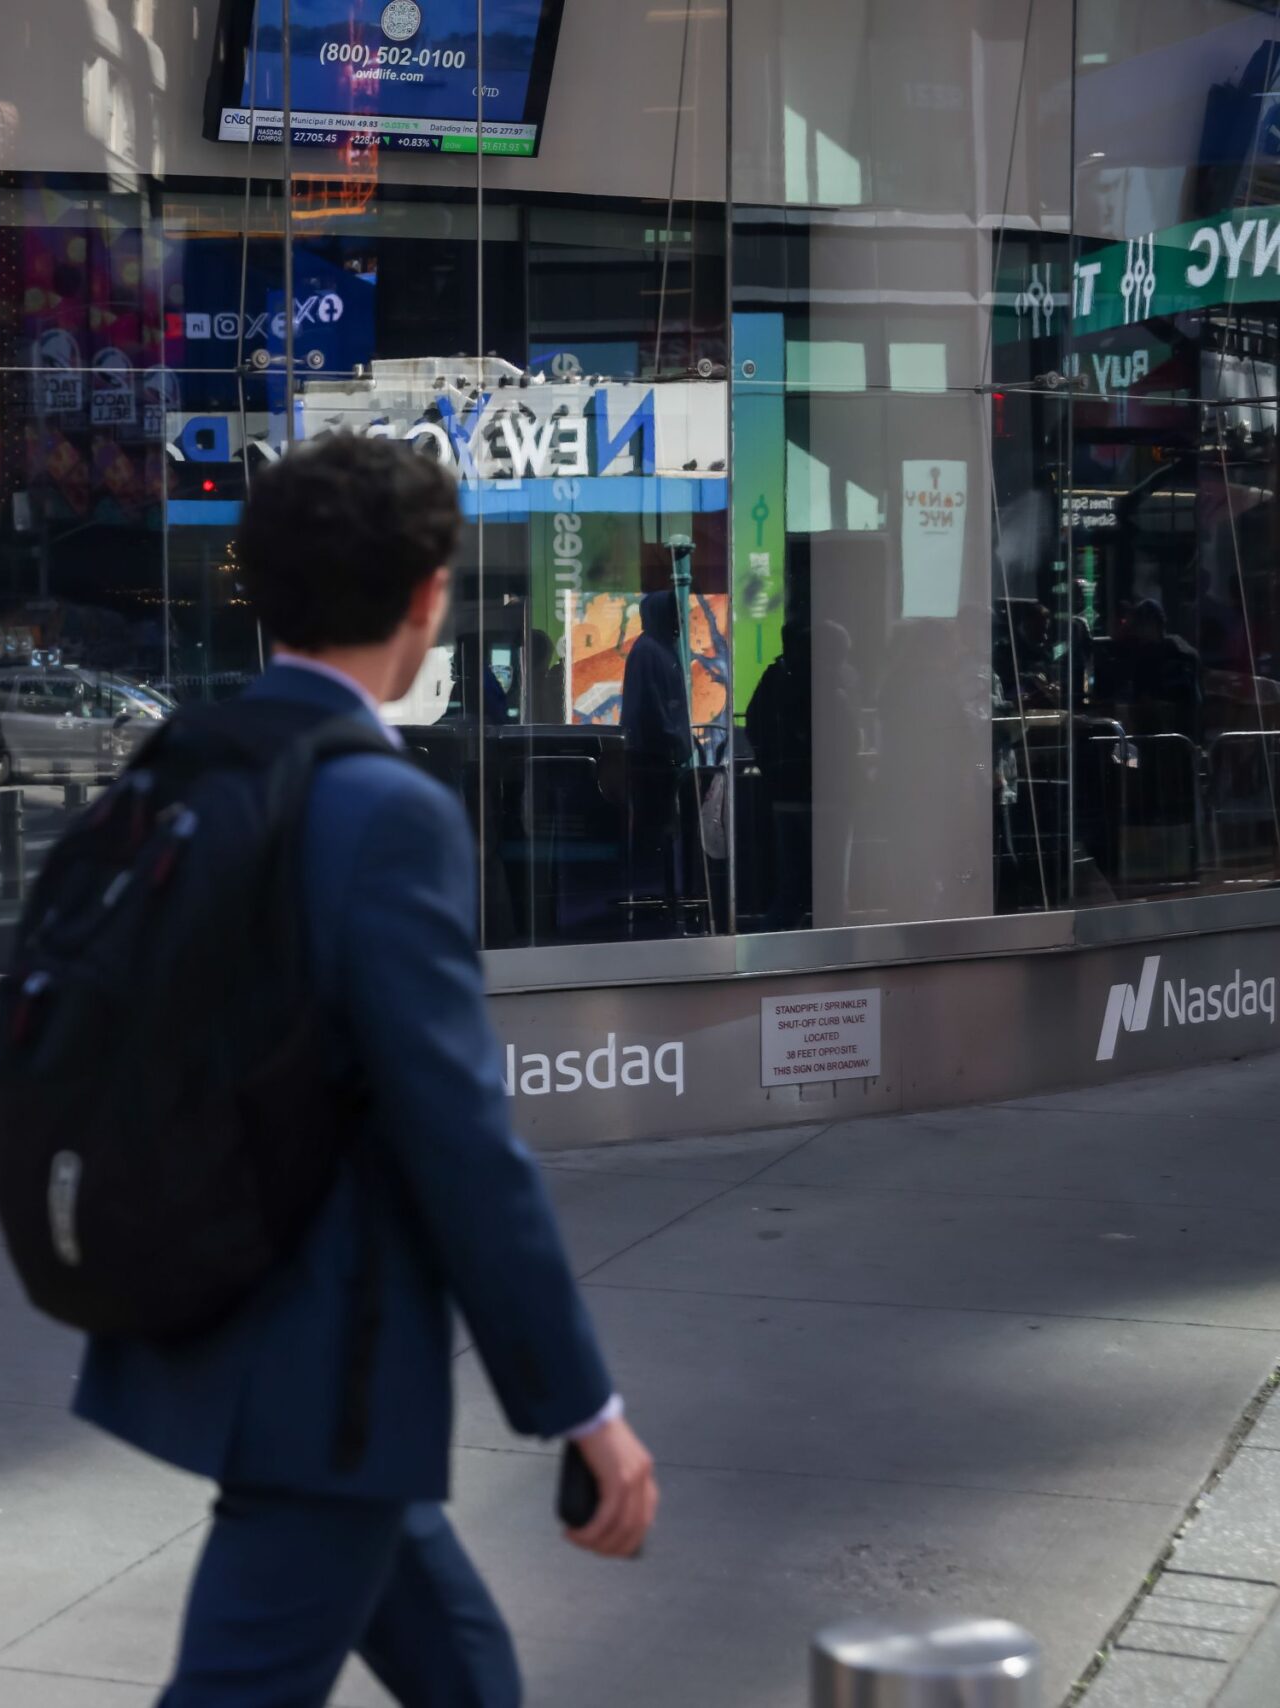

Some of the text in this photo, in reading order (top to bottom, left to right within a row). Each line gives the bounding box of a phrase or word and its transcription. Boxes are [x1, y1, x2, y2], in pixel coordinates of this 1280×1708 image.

[320, 42, 466, 69] (800) 502-0100
[355, 68, 424, 82] ovidlife.com
[224, 111, 251, 125] CNBC
[291, 117, 326, 126] Municipal
[430, 124, 461, 133] Datadog
[293, 132, 337, 143] 27,705.45
[350, 136, 381, 144] +228.14
[398, 138, 430, 148] +0.83%
[481, 142, 520, 151] 51,613.93
[1164, 969, 1275, 1027] Nasdaq
[775, 1003, 818, 1015] STANDPIPE
[824, 999, 868, 1011] SPRINKLER
[778, 1014, 865, 1030] SHUT-OFF CURB VALVE
[804, 1032, 840, 1043] LOCATED
[786, 1044, 858, 1060] 38 FEET OPPOSITE
[773, 1058, 871, 1076] THIS SIGN ON BROADWAY
